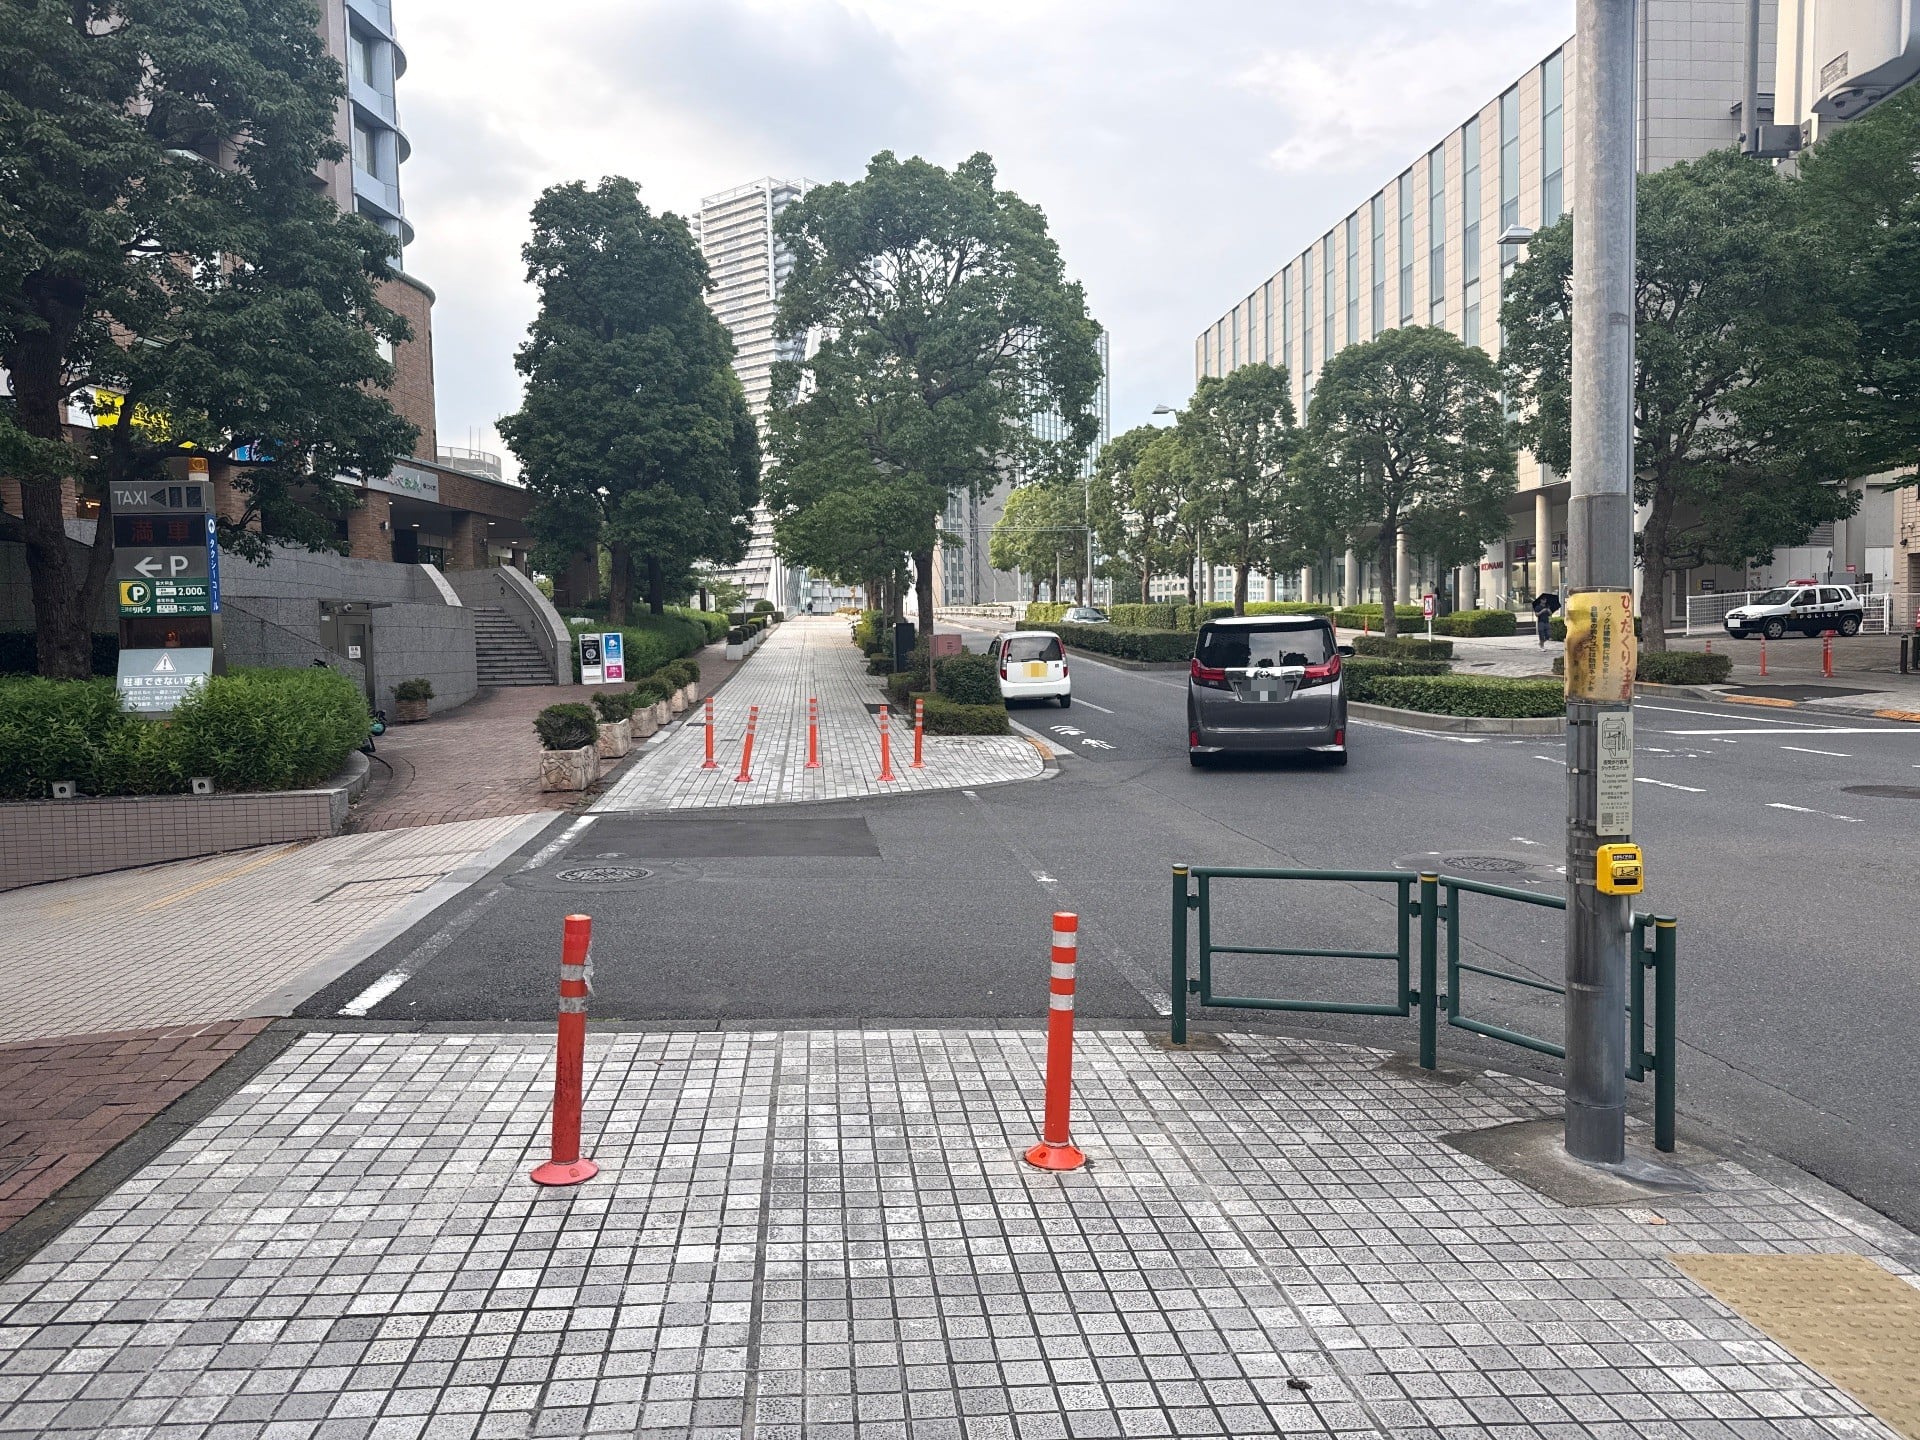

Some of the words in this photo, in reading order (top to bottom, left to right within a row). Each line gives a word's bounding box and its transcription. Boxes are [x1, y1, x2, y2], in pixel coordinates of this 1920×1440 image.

[114, 490, 147, 505] TAXI
[170, 555, 189, 577] P
[210, 539, 218, 611] タクシーコール
[1481, 561, 1504, 571] KONAMI
[1619, 594, 1632, 699] ひったくり注意
